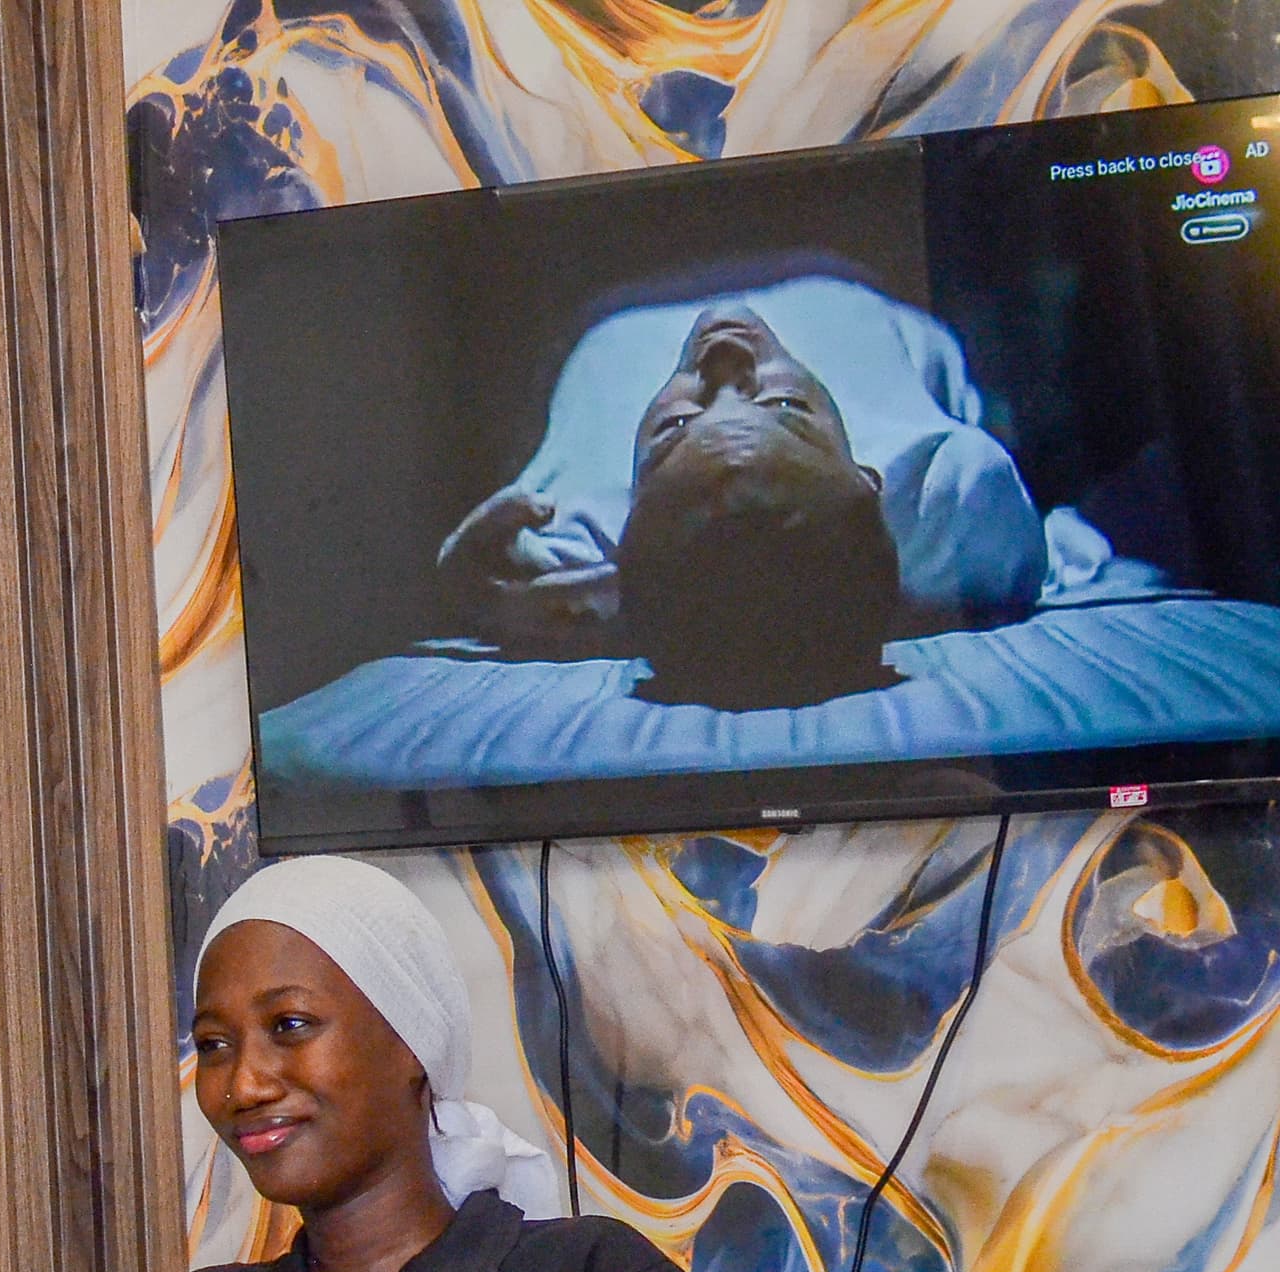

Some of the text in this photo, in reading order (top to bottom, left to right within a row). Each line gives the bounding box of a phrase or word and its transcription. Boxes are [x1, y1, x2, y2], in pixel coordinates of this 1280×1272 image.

[1245, 141, 1269, 159] AD
[1050, 150, 1203, 181] Press back to close
[1170, 189, 1256, 212] JioCinema
